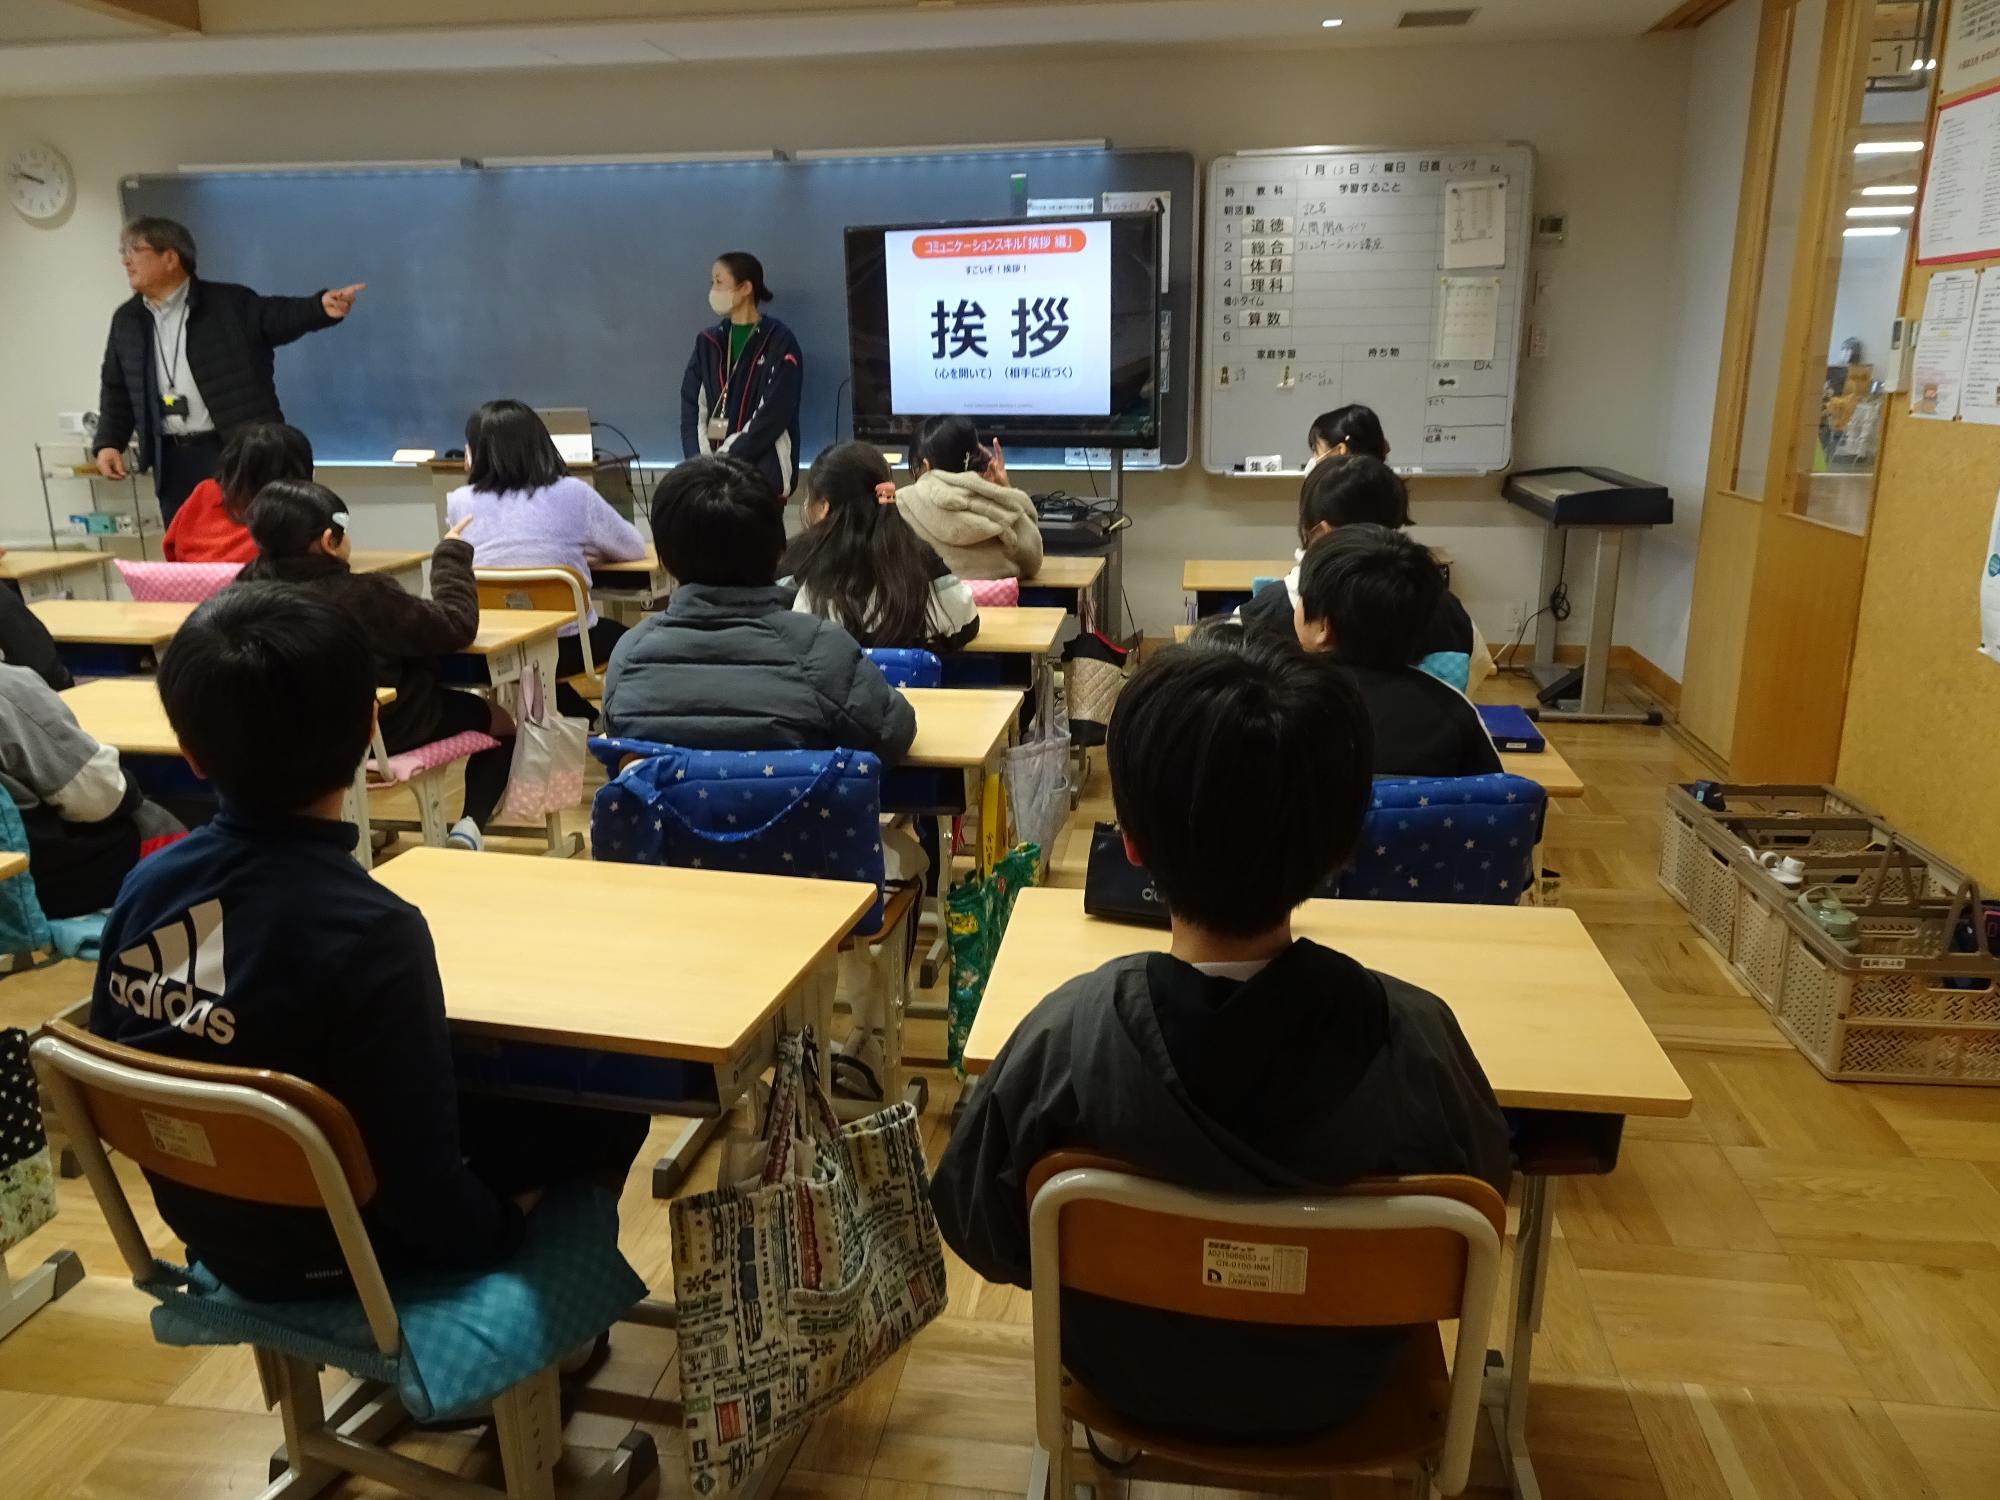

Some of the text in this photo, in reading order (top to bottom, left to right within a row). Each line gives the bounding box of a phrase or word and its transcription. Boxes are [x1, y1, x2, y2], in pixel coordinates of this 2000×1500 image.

[1338, 183, 1402, 195] 学習すること
[1223, 241, 1233, 252] 2
[109, 971, 236, 1045] adidas
